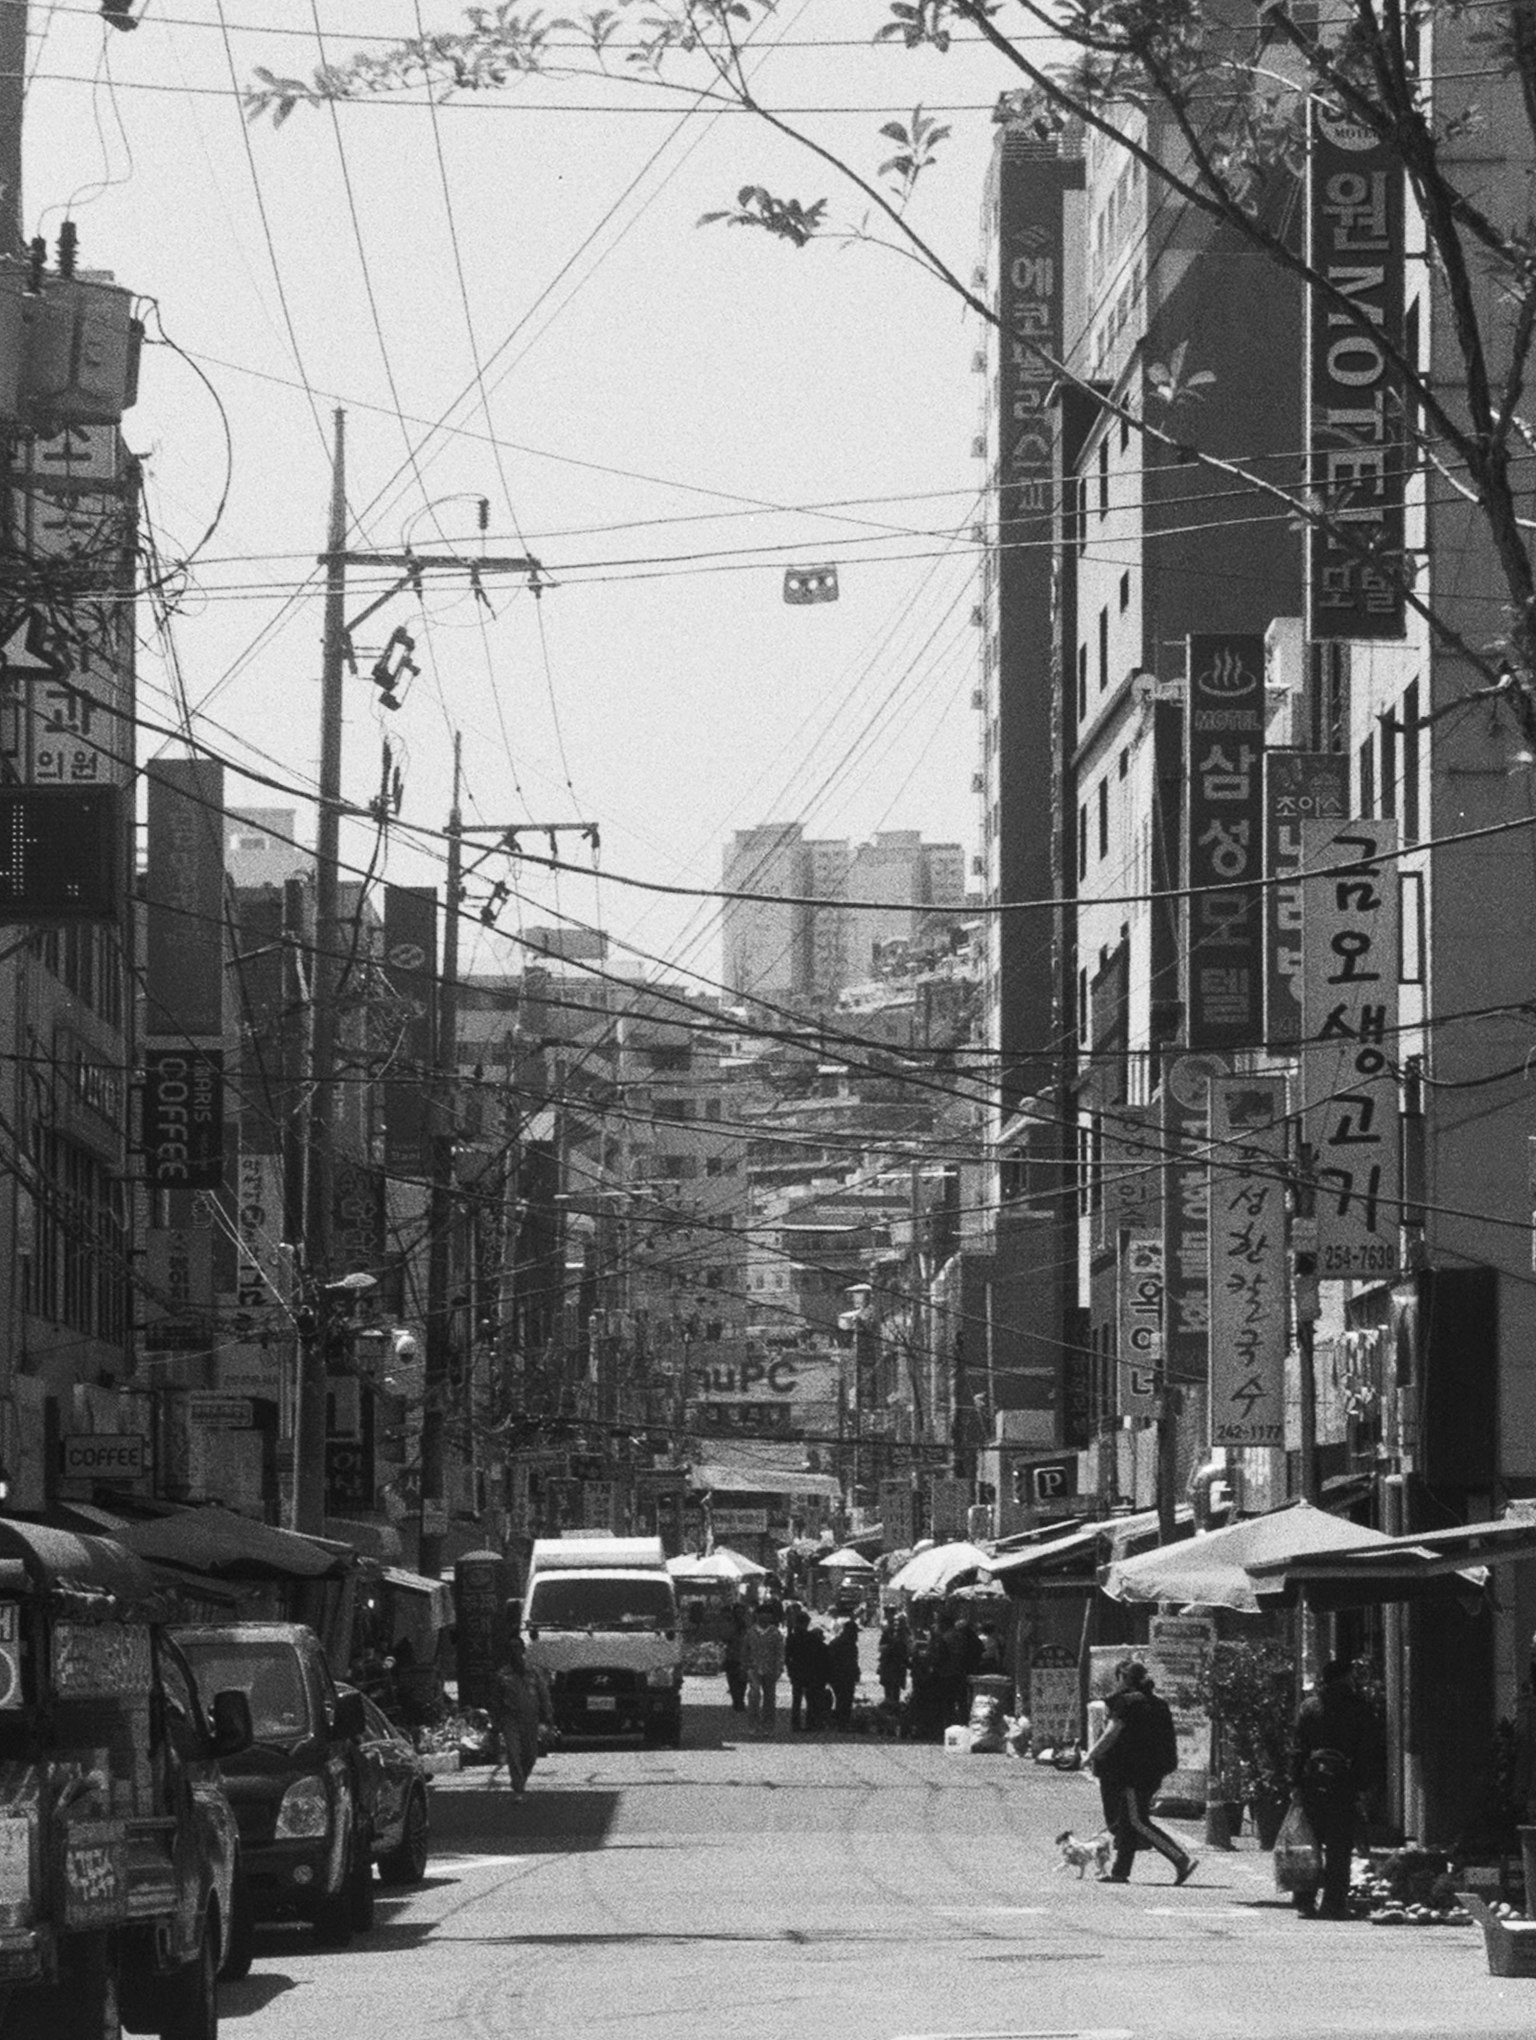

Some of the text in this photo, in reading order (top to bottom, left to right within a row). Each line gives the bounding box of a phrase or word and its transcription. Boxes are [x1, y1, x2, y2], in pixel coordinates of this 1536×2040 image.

[1322, 172, 1389, 549] 원 MOTEL
[1194, 709, 1262, 732] MOTEL
[37, 751, 97, 780] 의원
[1198, 744, 1257, 1023] 삼성모텔
[1318, 836, 1387, 1232] 금오생고기
[156, 1057, 188, 1179] COFFEE
[1216, 1425, 1283, 1440] 242-1177
[70, 1447, 139, 1466] COFFEE
[1043, 1472, 1063, 1496] P
